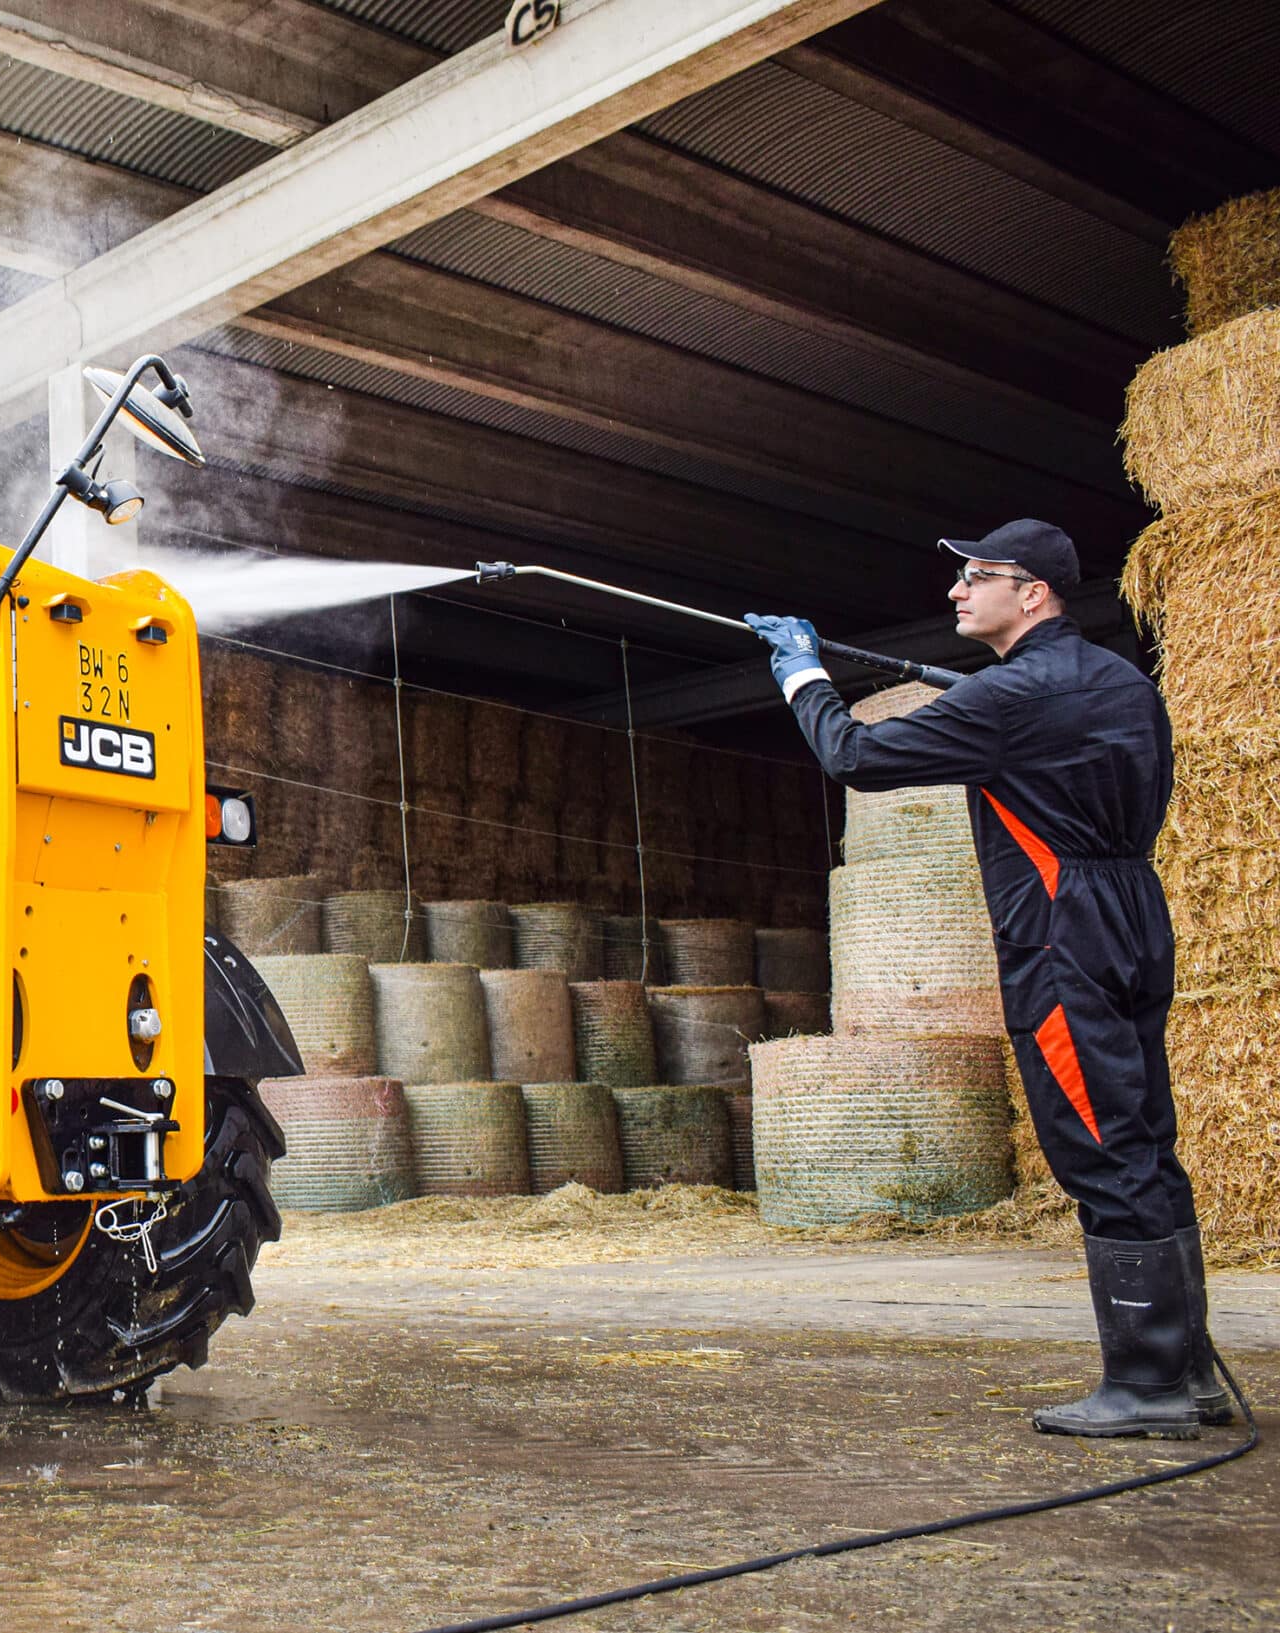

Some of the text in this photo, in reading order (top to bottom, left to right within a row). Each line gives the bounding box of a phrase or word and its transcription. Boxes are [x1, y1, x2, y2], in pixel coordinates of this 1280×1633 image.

[512, 0, 556, 46] C5
[79, 644, 129, 683] BW 6
[63, 724, 153, 774] JCB
